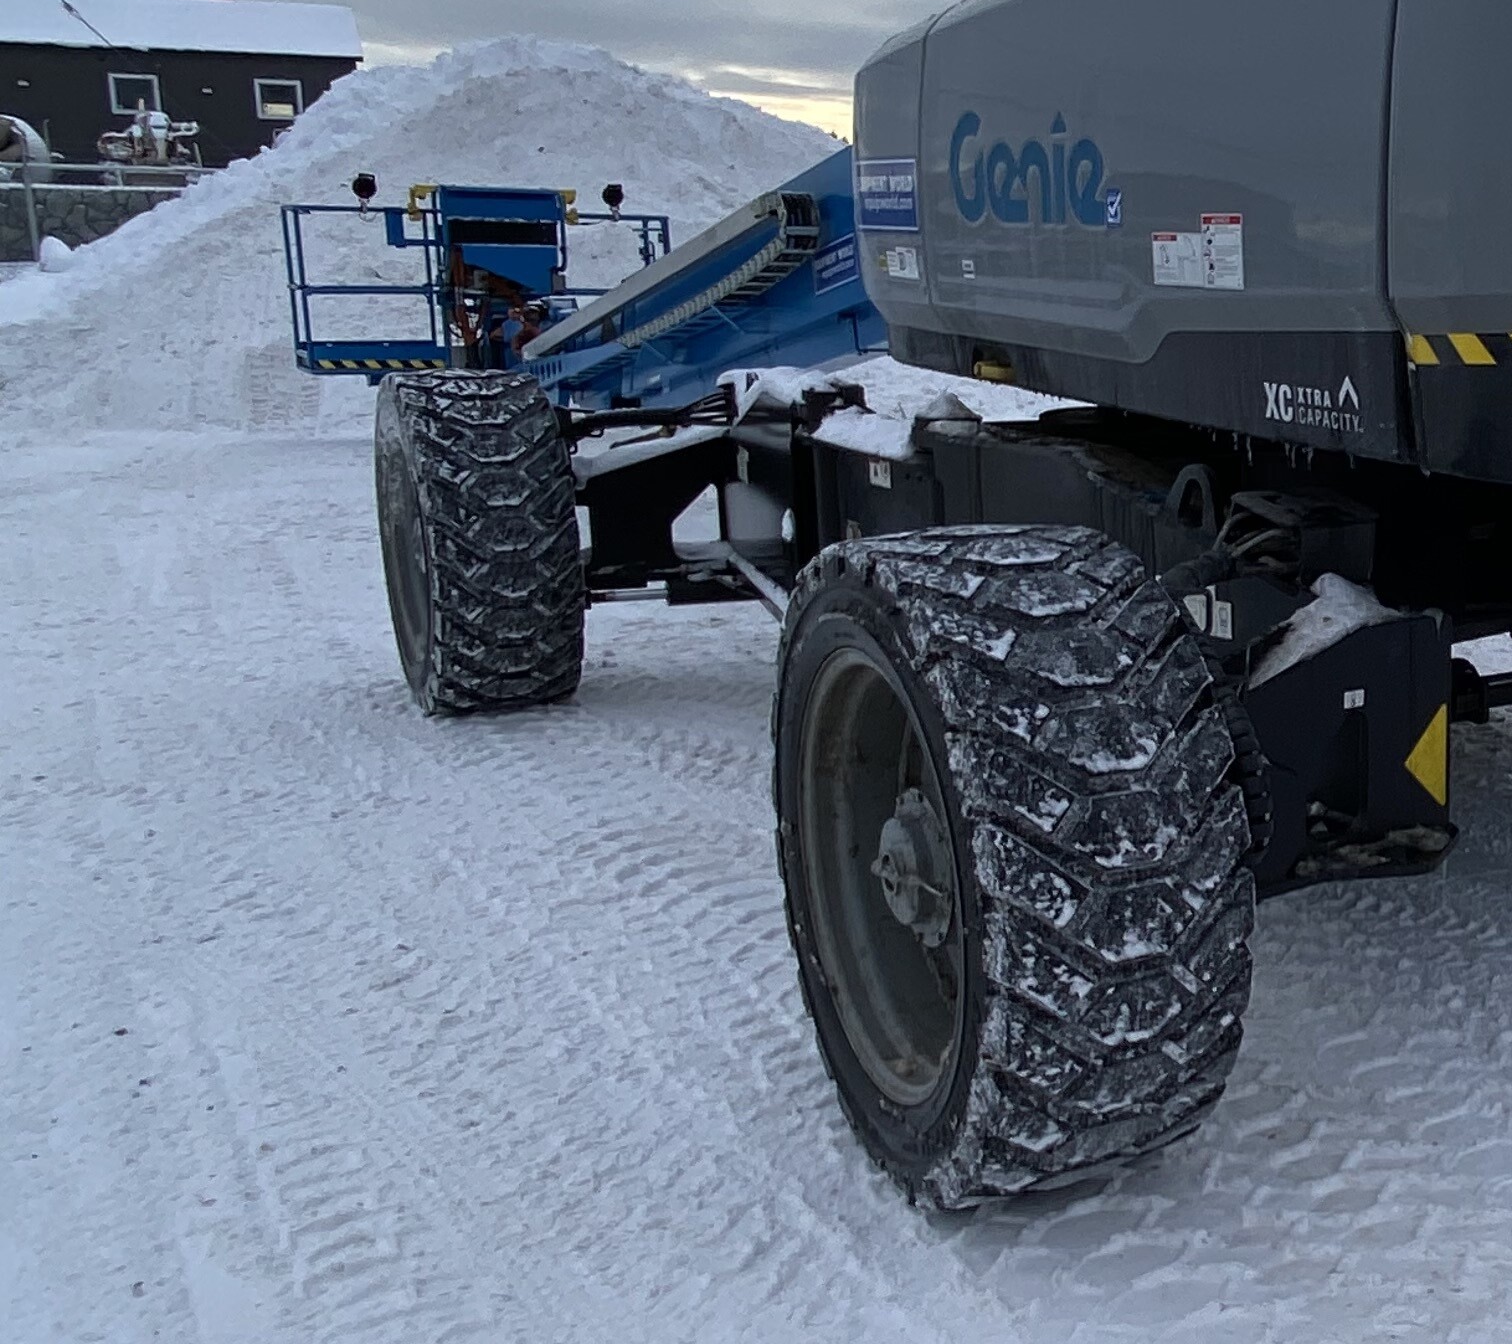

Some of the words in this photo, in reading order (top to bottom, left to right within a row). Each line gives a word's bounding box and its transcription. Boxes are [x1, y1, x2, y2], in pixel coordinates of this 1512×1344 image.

[950, 111, 1105, 225] Genie
[1264, 381, 1293, 423] XC
[1298, 387, 1332, 408] XTRA
[1299, 406, 1360, 432] CAPACITY
